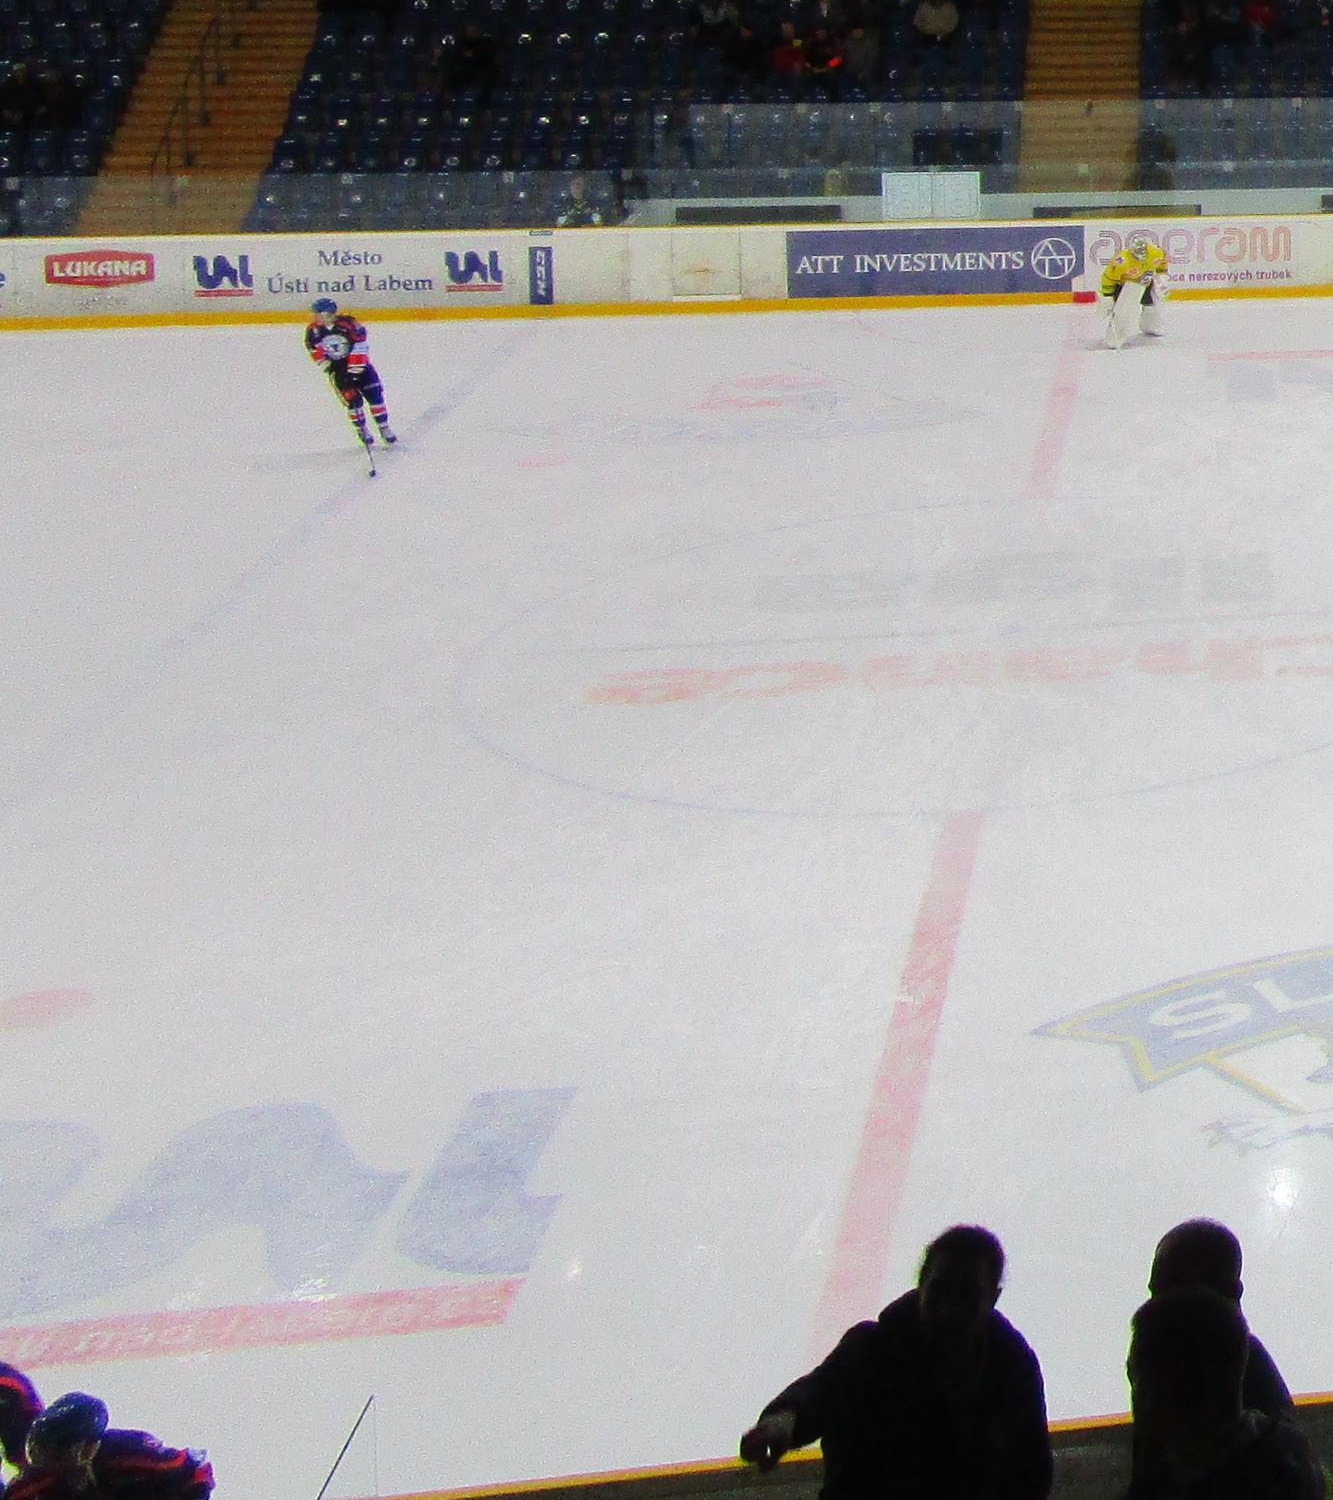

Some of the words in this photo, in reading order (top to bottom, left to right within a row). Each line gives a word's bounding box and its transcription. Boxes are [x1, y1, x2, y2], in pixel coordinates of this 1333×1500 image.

[317, 250, 383, 267] Město
[796, 255, 844, 274] ATT
[854, 251, 1026, 273] INVESTMENTS
[53, 260, 147, 277] LUKANA
[1189, 270, 1253, 284] nerezových
[1256, 269, 1292, 281] trubek
[267, 273, 309, 293] Ústí
[317, 275, 356, 293] nad
[363, 274, 433, 292] Labem
